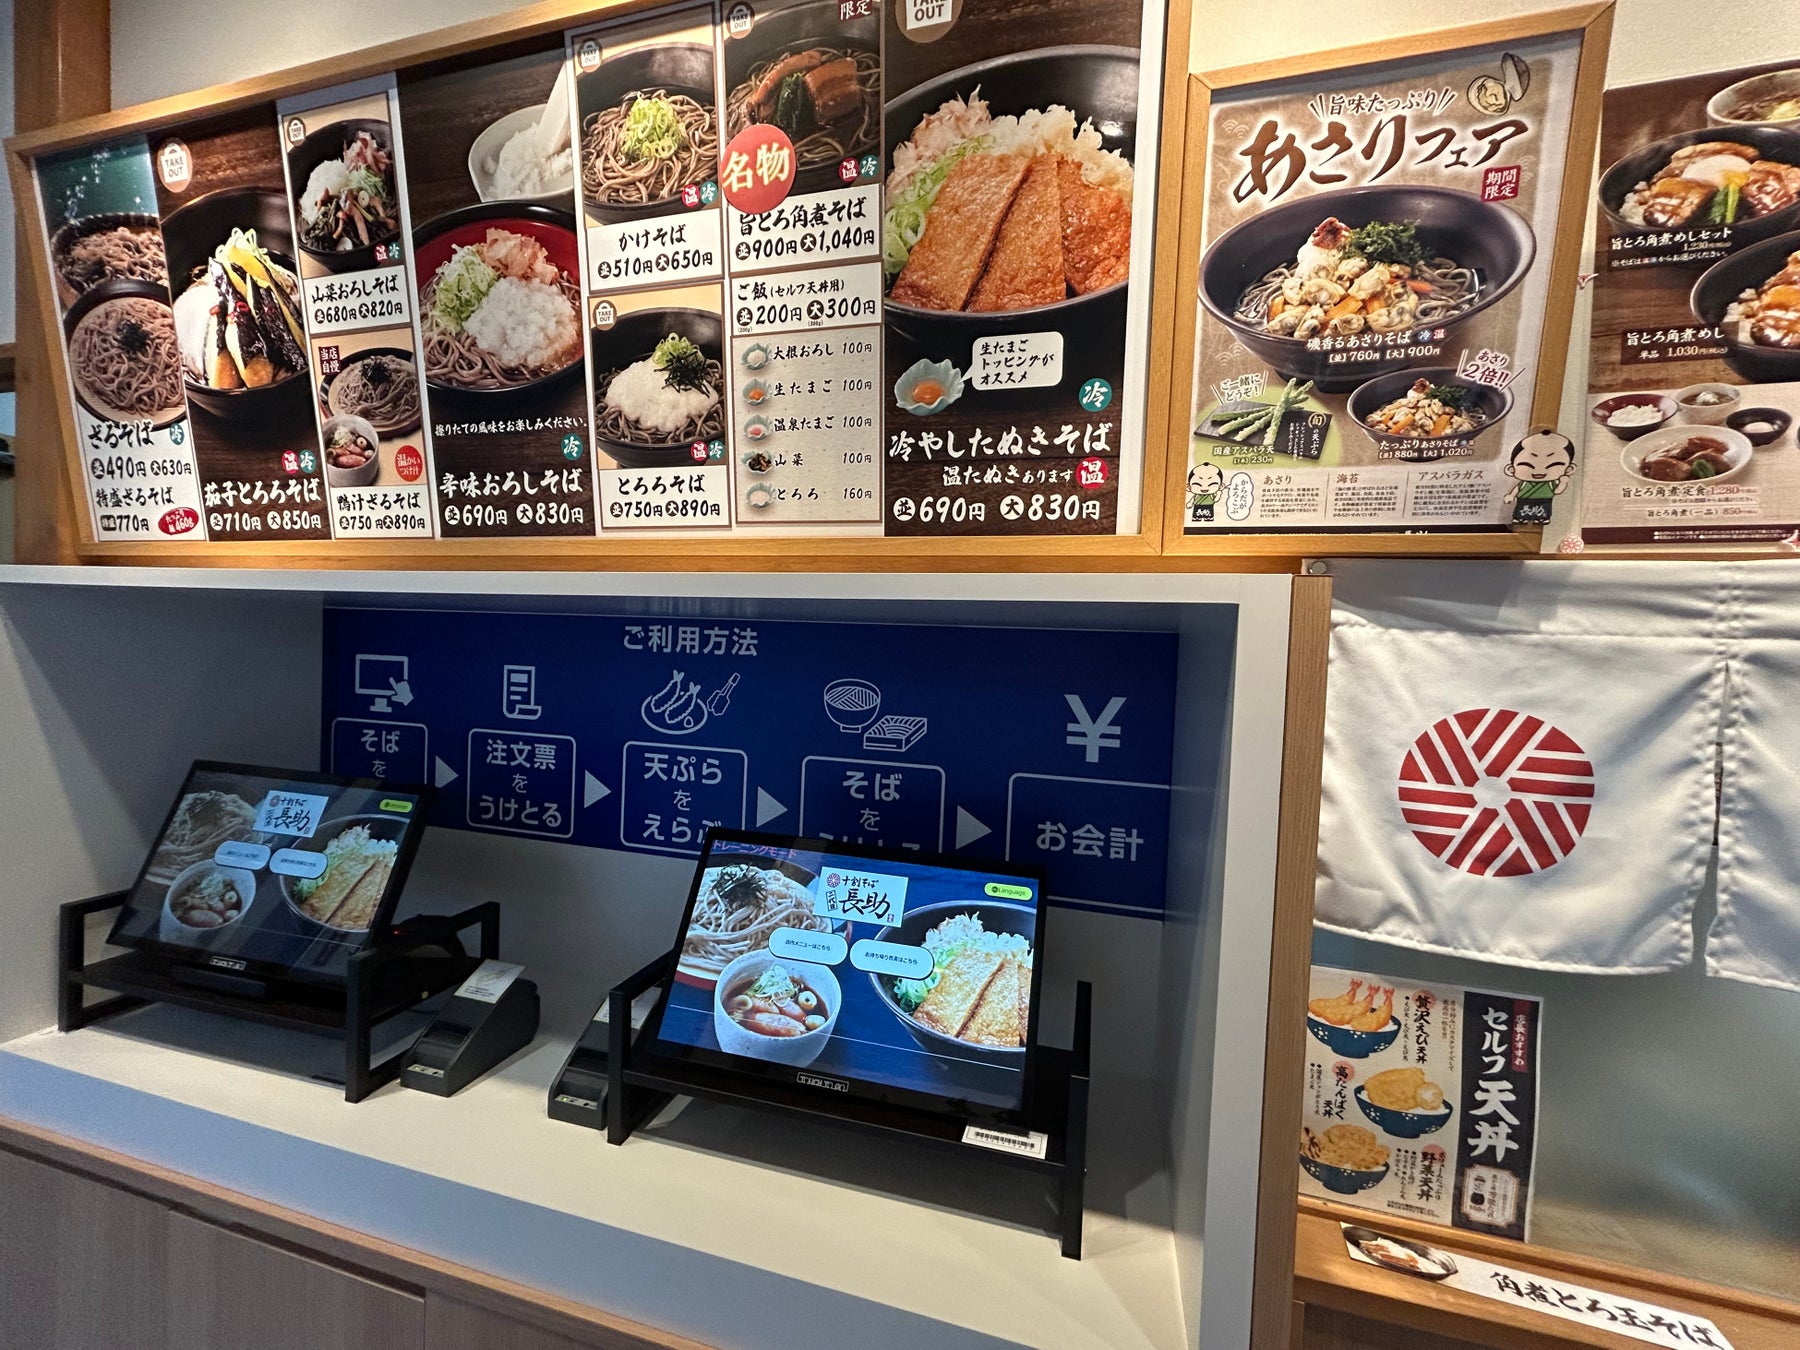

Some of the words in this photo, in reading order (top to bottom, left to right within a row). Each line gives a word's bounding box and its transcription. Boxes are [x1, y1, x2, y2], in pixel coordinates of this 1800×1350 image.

[914, 4, 944, 21] OUT
[1328, 89, 1437, 116] 旨味たっぷり
[165, 157, 184, 167] TAKE
[722, 142, 790, 192] 名物
[1233, 115, 1529, 203] あさりフェア
[168, 167, 184, 177] OUT
[1486, 168, 1517, 185] 期間
[1485, 184, 1516, 200] 限定
[618, 223, 686, 252] かけそば
[312, 274, 399, 304] 山菜おろしそば
[599, 315, 611, 323] OUT
[1306, 330, 1412, 351] 磯香るあさりそば
[1627, 327, 1725, 346] 旨とろ角煮めし
[773, 343, 835, 360] 大根おろし
[842, 342, 872, 355] 100円
[979, 339, 1030, 356] 生たまご
[981, 353, 1055, 371] トッピングが
[1477, 350, 1508, 367] あさり
[773, 379, 833, 397] 生たまご
[842, 379, 872, 392] 100円
[979, 371, 1028, 386] オススメ
[773, 416, 836, 432] 温泉たまご
[842, 416, 872, 429] 100円
[88, 421, 155, 449] ざるそば
[889, 422, 1113, 462] 冷やしたぬきそば
[774, 454, 804, 467] 山菜
[842, 452, 872, 465] 100円
[439, 467, 582, 499] 辛味おろしそば
[617, 474, 706, 495] とろろそば
[942, 465, 1073, 487] 温たぬきあります
[1264, 475, 1292, 486] あさり
[1336, 473, 1359, 484] 海苔
[1418, 470, 1484, 481] アスパラガス
[96, 486, 175, 508] 特盛ざるそば
[204, 478, 322, 508] 茄子とろろそば
[337, 492, 421, 511] 鴨汁ざるそば
[776, 487, 819, 501] とろろ
[842, 487, 872, 500] 160円
[623, 625, 758, 656] ご利用方法
[360, 730, 400, 754] そば
[486, 739, 556, 770] 注文票
[372, 759, 386, 778] を
[643, 753, 722, 784] 天ぷら
[512, 773, 527, 794] を
[843, 771, 902, 801] そば
[673, 790, 692, 811] を
[479, 795, 562, 828] うけとる
[859, 809, 880, 831] を
[713, 840, 797, 859] トレーニングモード
[1036, 821, 1144, 862] お会計
[998, 886, 1027, 897] Language
[839, 888, 890, 919] 長助
[1335, 1065, 1348, 1120] 高たんぱく
[1490, 1271, 1726, 1350] 角煮とろ玉そば
